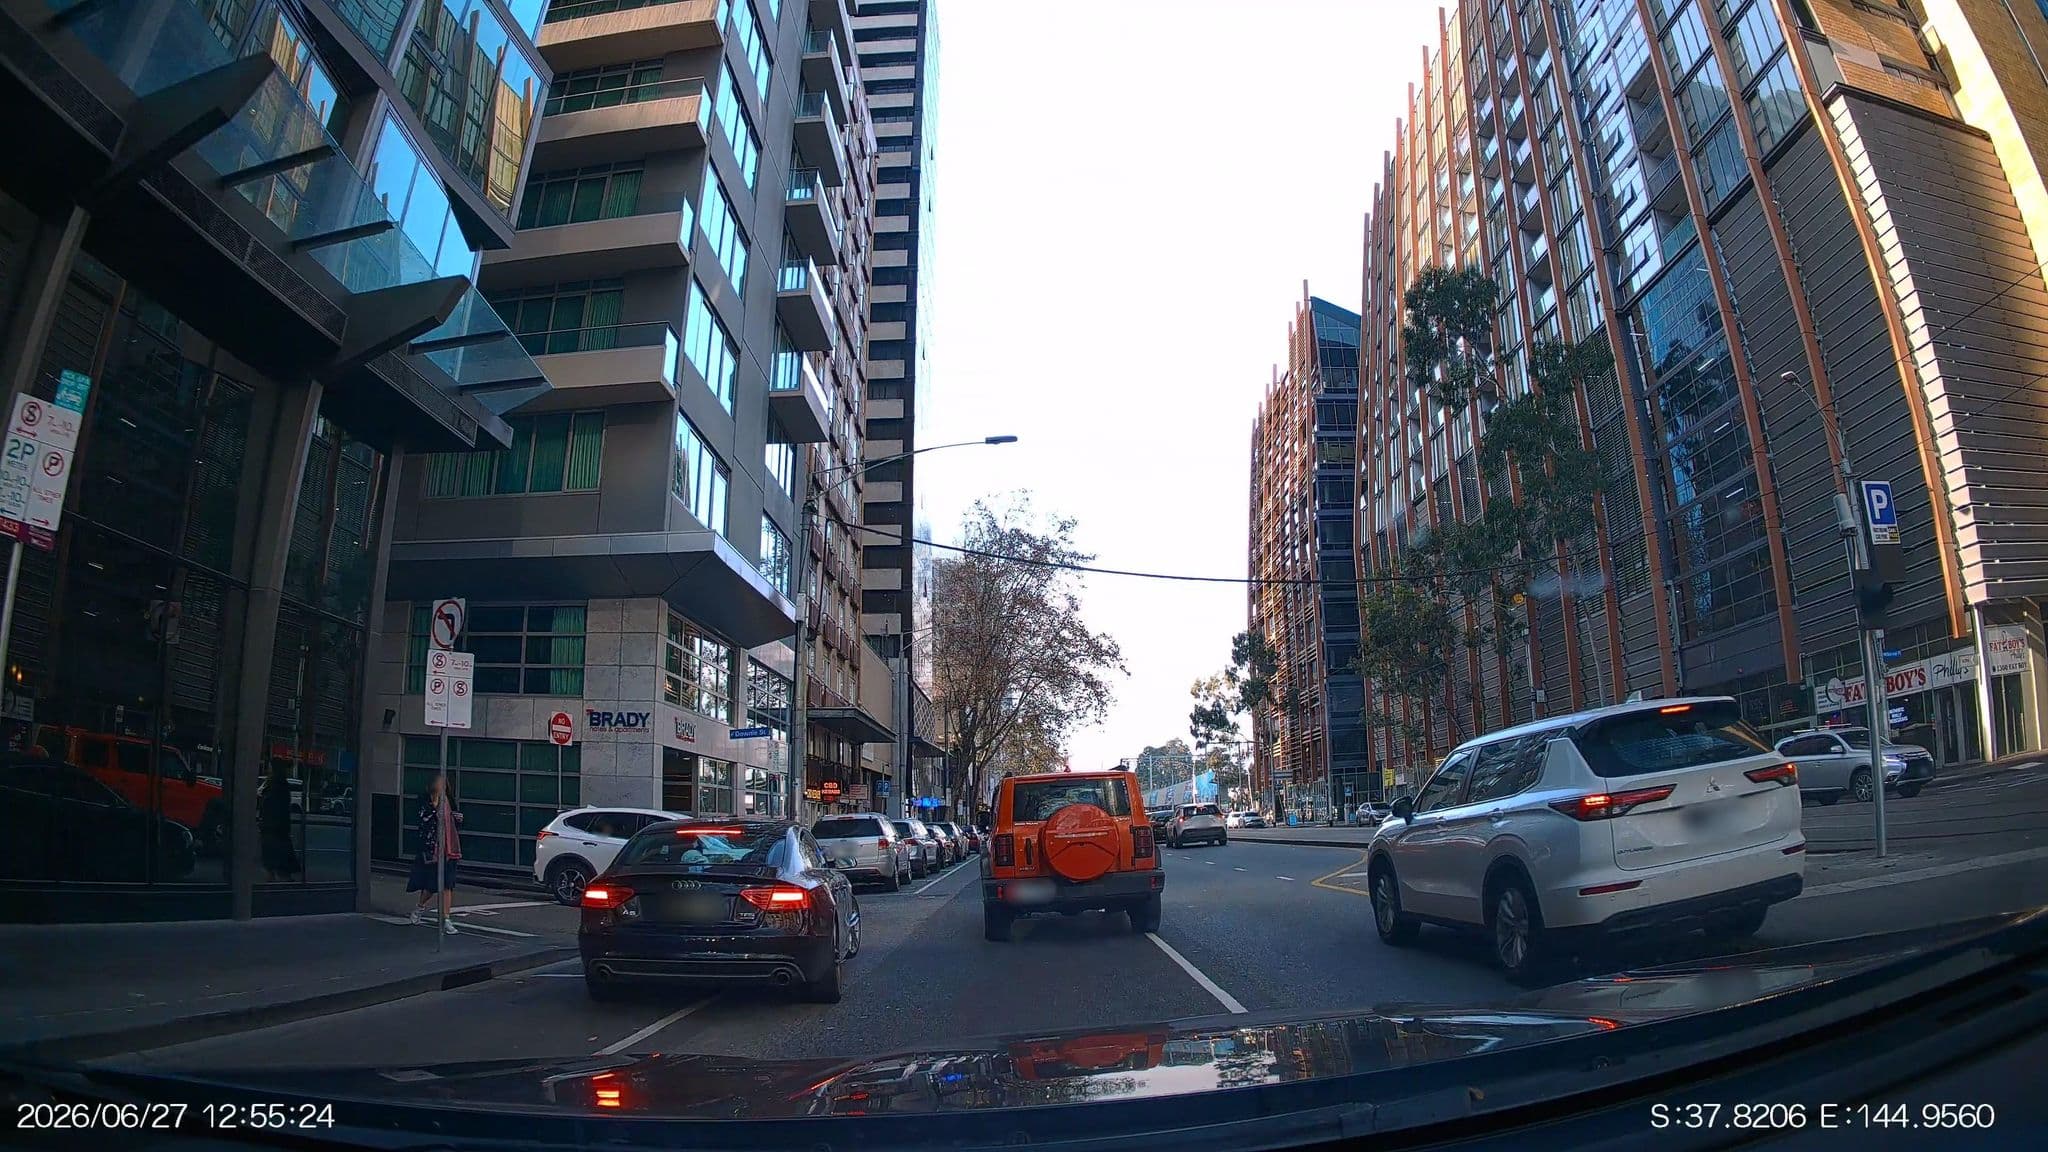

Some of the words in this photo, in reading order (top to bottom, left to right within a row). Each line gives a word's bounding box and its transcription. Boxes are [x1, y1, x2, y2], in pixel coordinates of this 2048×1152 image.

[7, 439, 36, 461] 2P
[1871, 489, 1888, 519] P
[1886, 667, 1927, 693] BOY'S
[589, 711, 651, 727] BRADY
